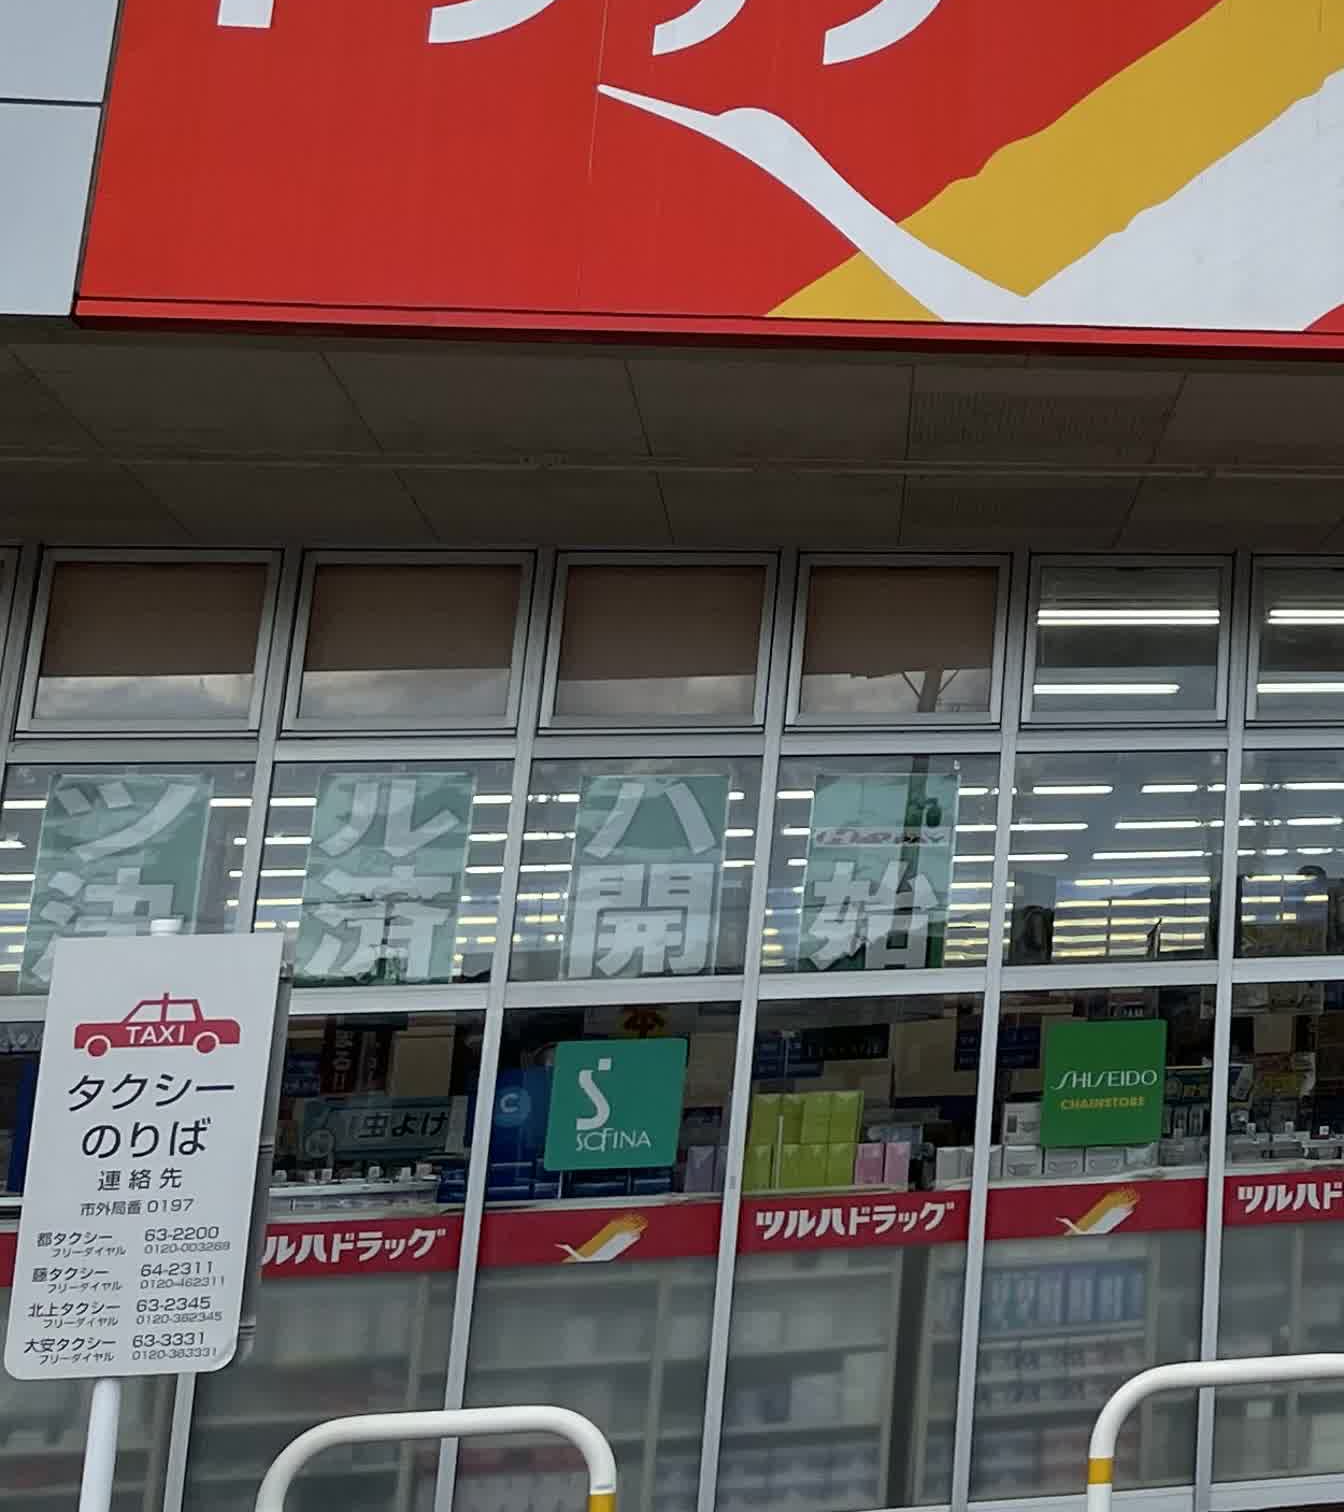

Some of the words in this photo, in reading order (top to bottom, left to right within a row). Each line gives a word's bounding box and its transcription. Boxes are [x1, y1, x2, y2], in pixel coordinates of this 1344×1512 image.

[126, 1025, 185, 1044] TAXI
[1052, 1069, 1158, 1090] SHISEIDO
[68, 1073, 235, 1112] タクシー
[82, 1116, 212, 1159] のりば
[576, 1128, 652, 1152] SOFINA
[97, 1168, 183, 1191] 連絡先
[80, 1200, 142, 1217] 市外局番
[147, 1198, 195, 1214] 0197
[756, 1201, 955, 1240] ツルハドラッグ
[144, 1226, 220, 1242] 63-2200
[140, 1261, 213, 1277] 64-2311
[28, 1301, 121, 1318] 北上タクシー
[136, 1296, 212, 1313] 63-2345
[24, 1337, 117, 1354] 大安タクシー
[132, 1331, 205, 1348] 63-3331
